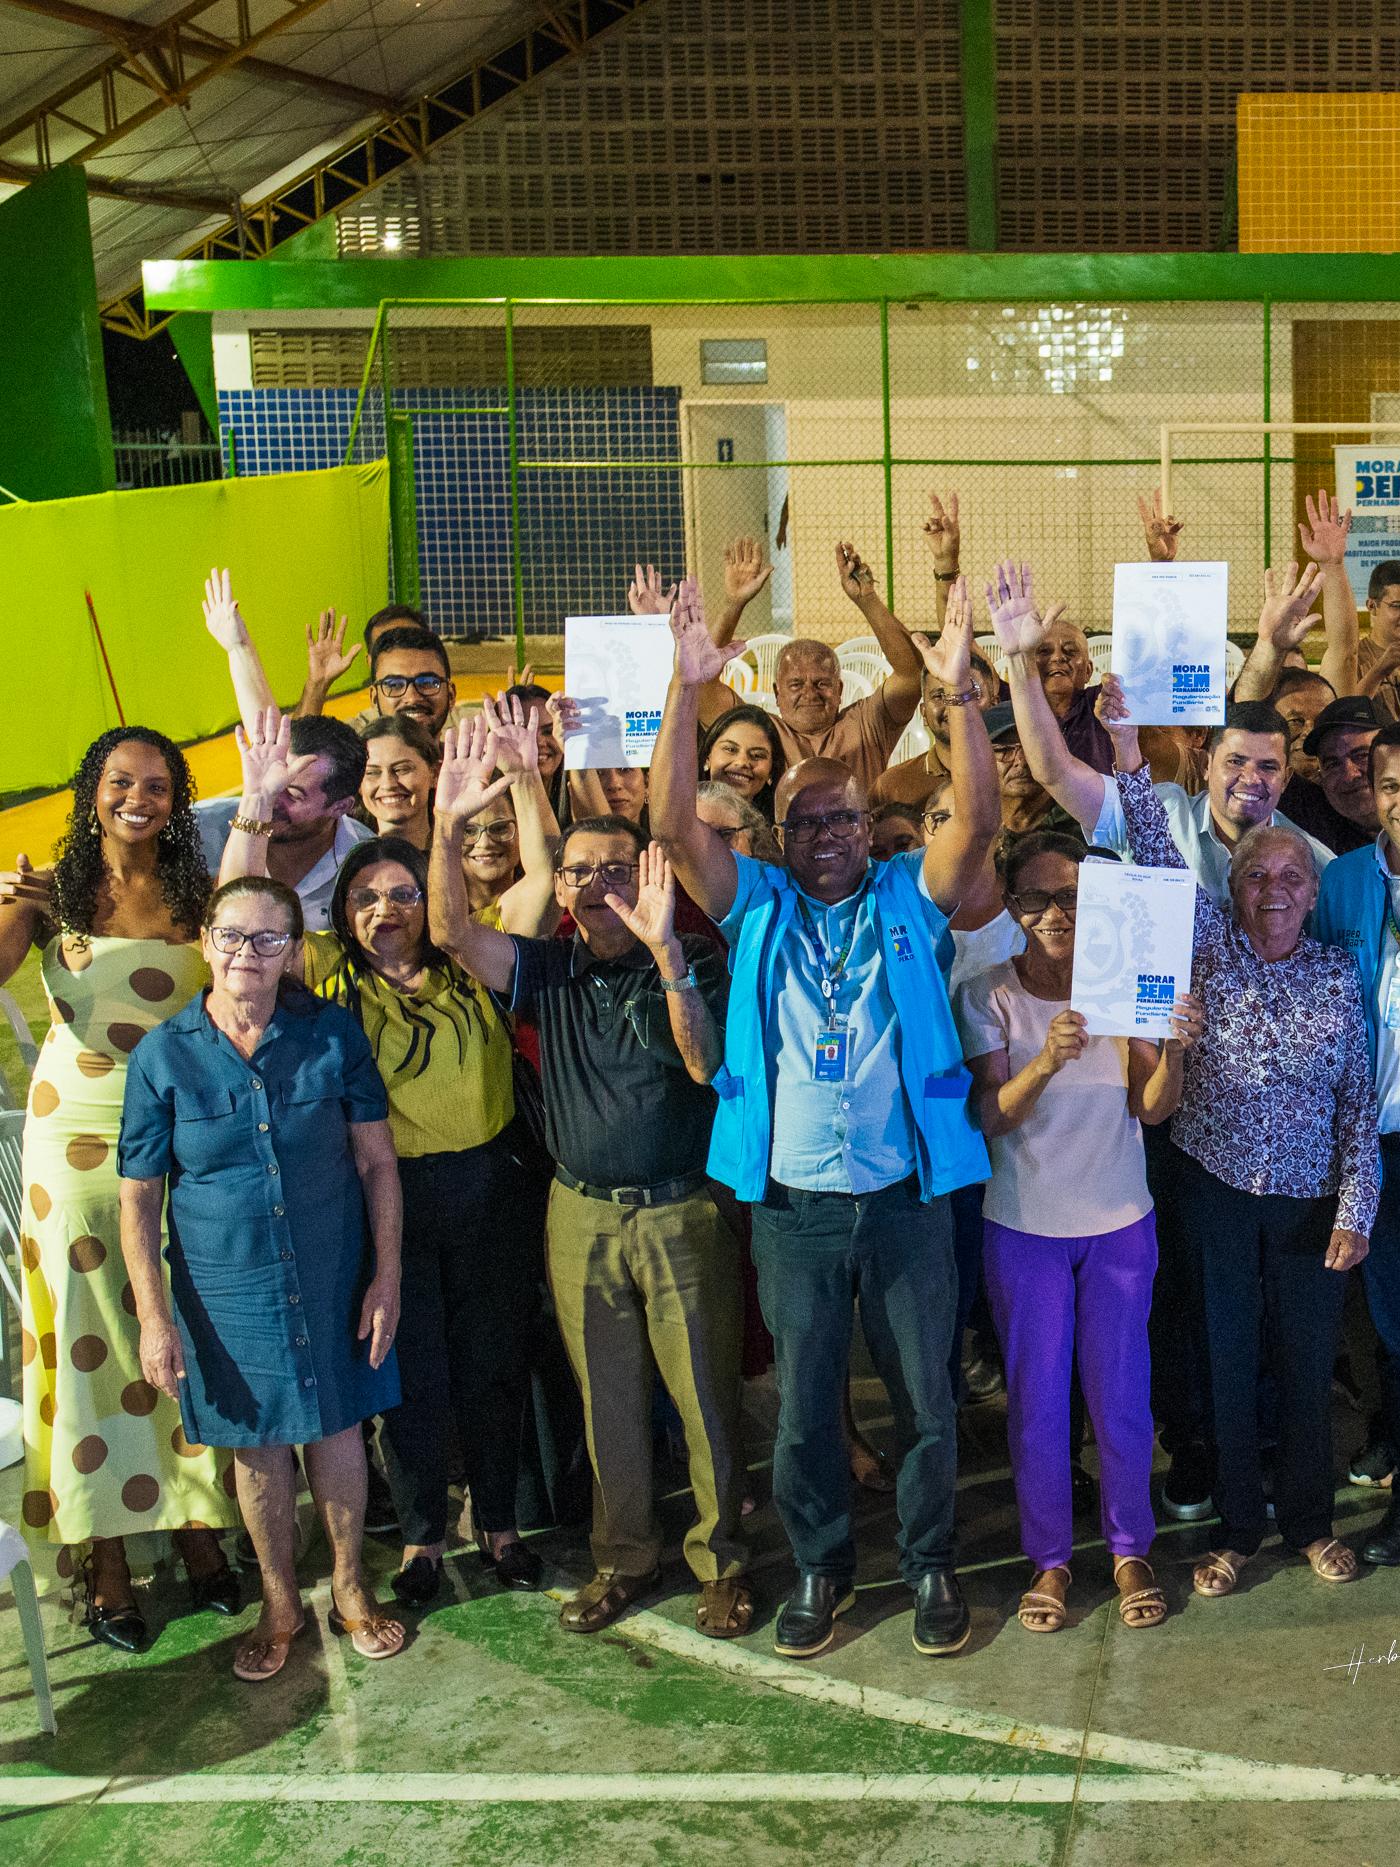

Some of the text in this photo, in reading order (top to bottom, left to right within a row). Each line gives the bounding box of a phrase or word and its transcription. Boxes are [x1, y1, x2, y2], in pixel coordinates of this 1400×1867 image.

[1173, 665, 1210, 673] MORAR
[1173, 674, 1210, 687] BEM
[626, 719, 661, 731] BEM
[1137, 974, 1175, 984] MORAR
[1136, 983, 1175, 999] BEM
